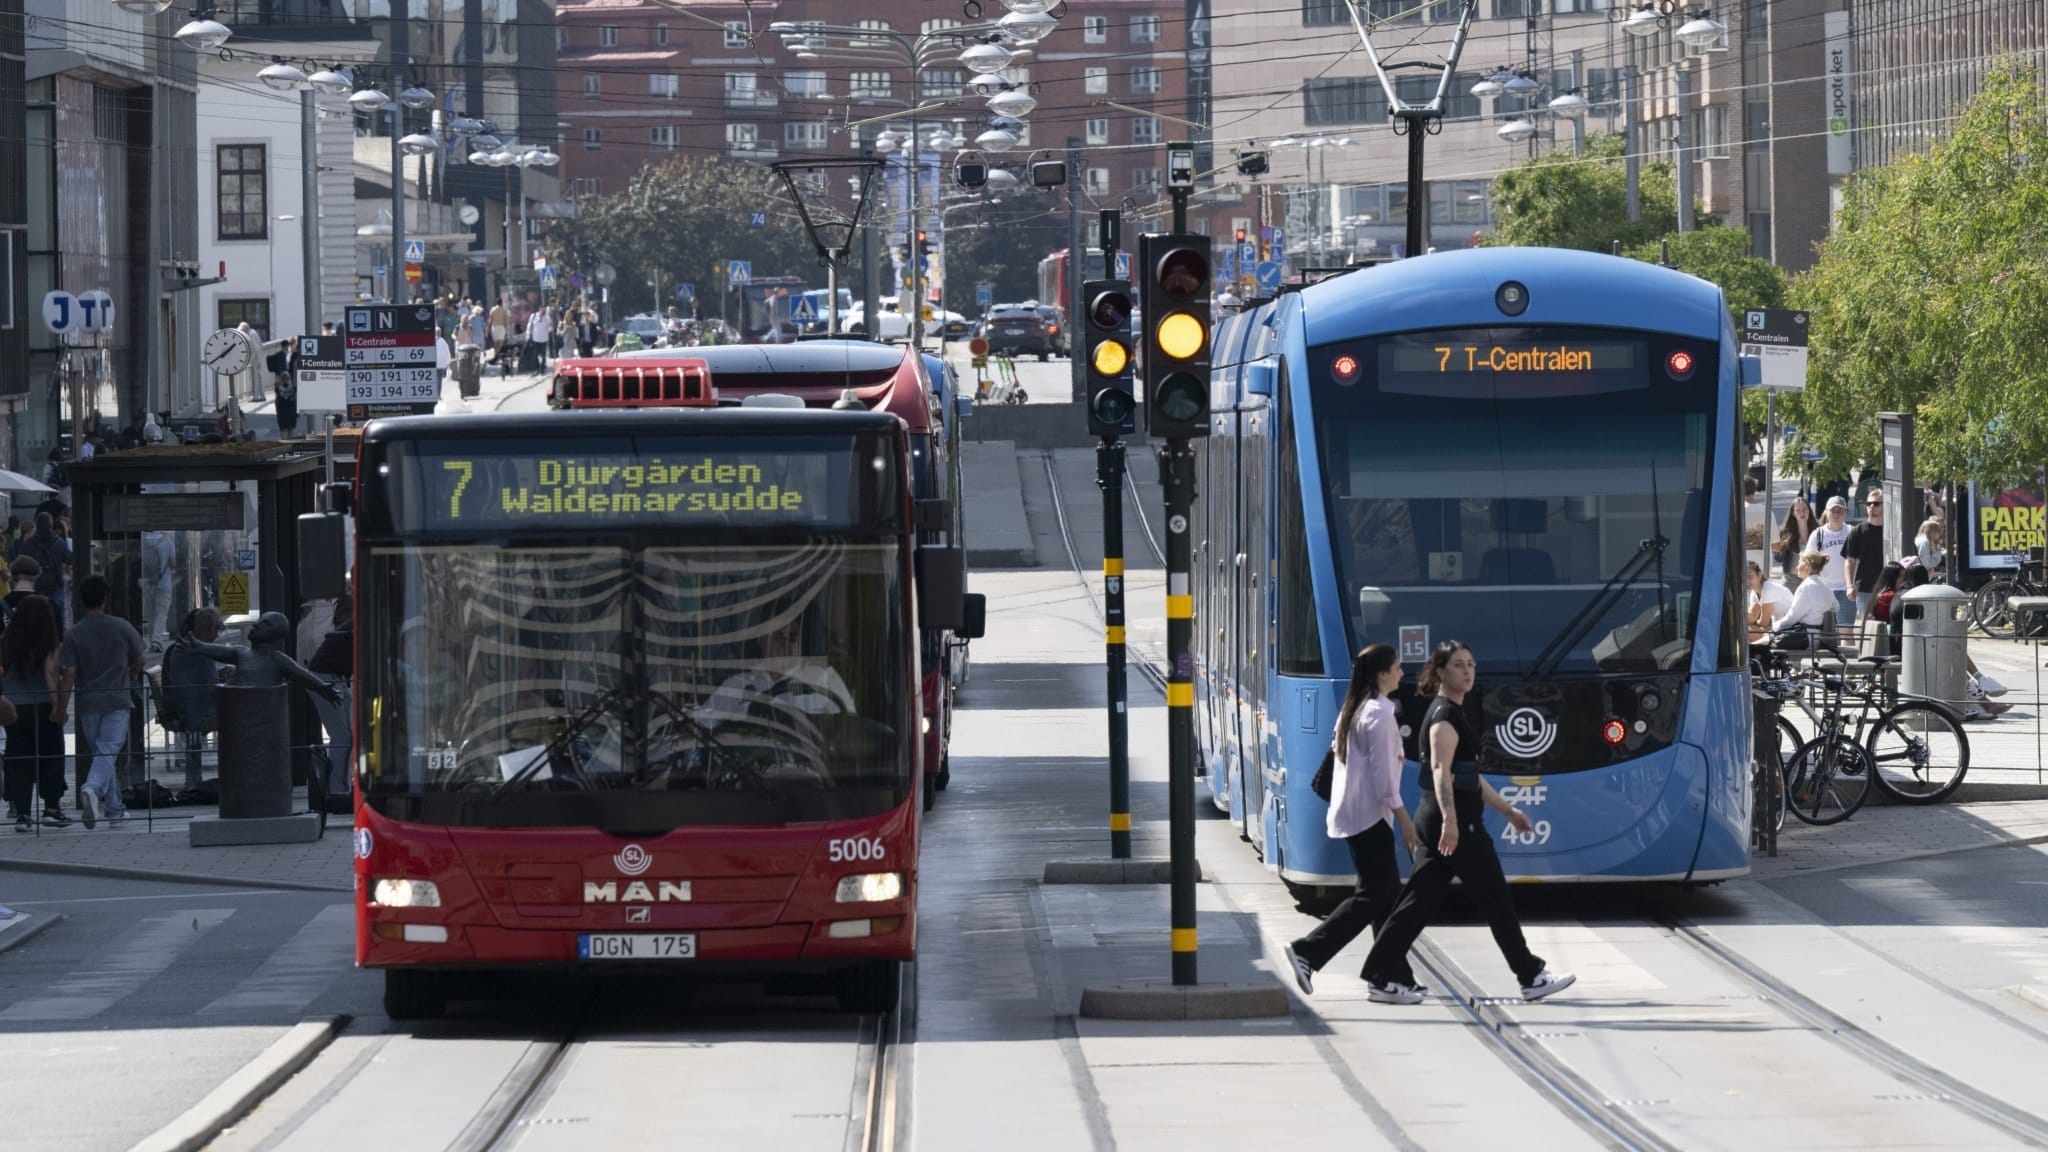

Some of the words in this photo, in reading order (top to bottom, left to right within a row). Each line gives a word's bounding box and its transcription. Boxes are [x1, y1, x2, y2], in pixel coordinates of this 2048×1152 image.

[752, 213, 764, 224] 74
[1243, 246, 1253, 260] P
[52, 297, 69, 330] J
[379, 311, 393, 329] N
[350, 337, 397, 347] T-Centralen
[1746, 332, 1789, 343] T-Centralen
[350, 350, 365, 361] 54
[380, 350, 395, 361] 65
[409, 349, 425, 360] 69
[1435, 347, 1451, 372] 7
[1465, 346, 1592, 372] T-Centralen
[301, 359, 343, 369] T-Centralen
[350, 372, 372, 383] 190
[381, 371, 402, 381] 191
[411, 370, 433, 381] 192
[351, 387, 373, 398] 193
[381, 386, 403, 397] 194
[411, 385, 433, 396] 195
[443, 461, 473, 518] 7
[539, 458, 761, 488] Djurgården
[502, 485, 802, 512] Waldemarsudde
[1981, 506, 2046, 531] PARK
[1403, 642, 1425, 656] 15
[828, 838, 885, 862] 5006
[584, 881, 692, 903] MAN
[592, 936, 634, 956] DGN
[652, 936, 691, 956] 175
